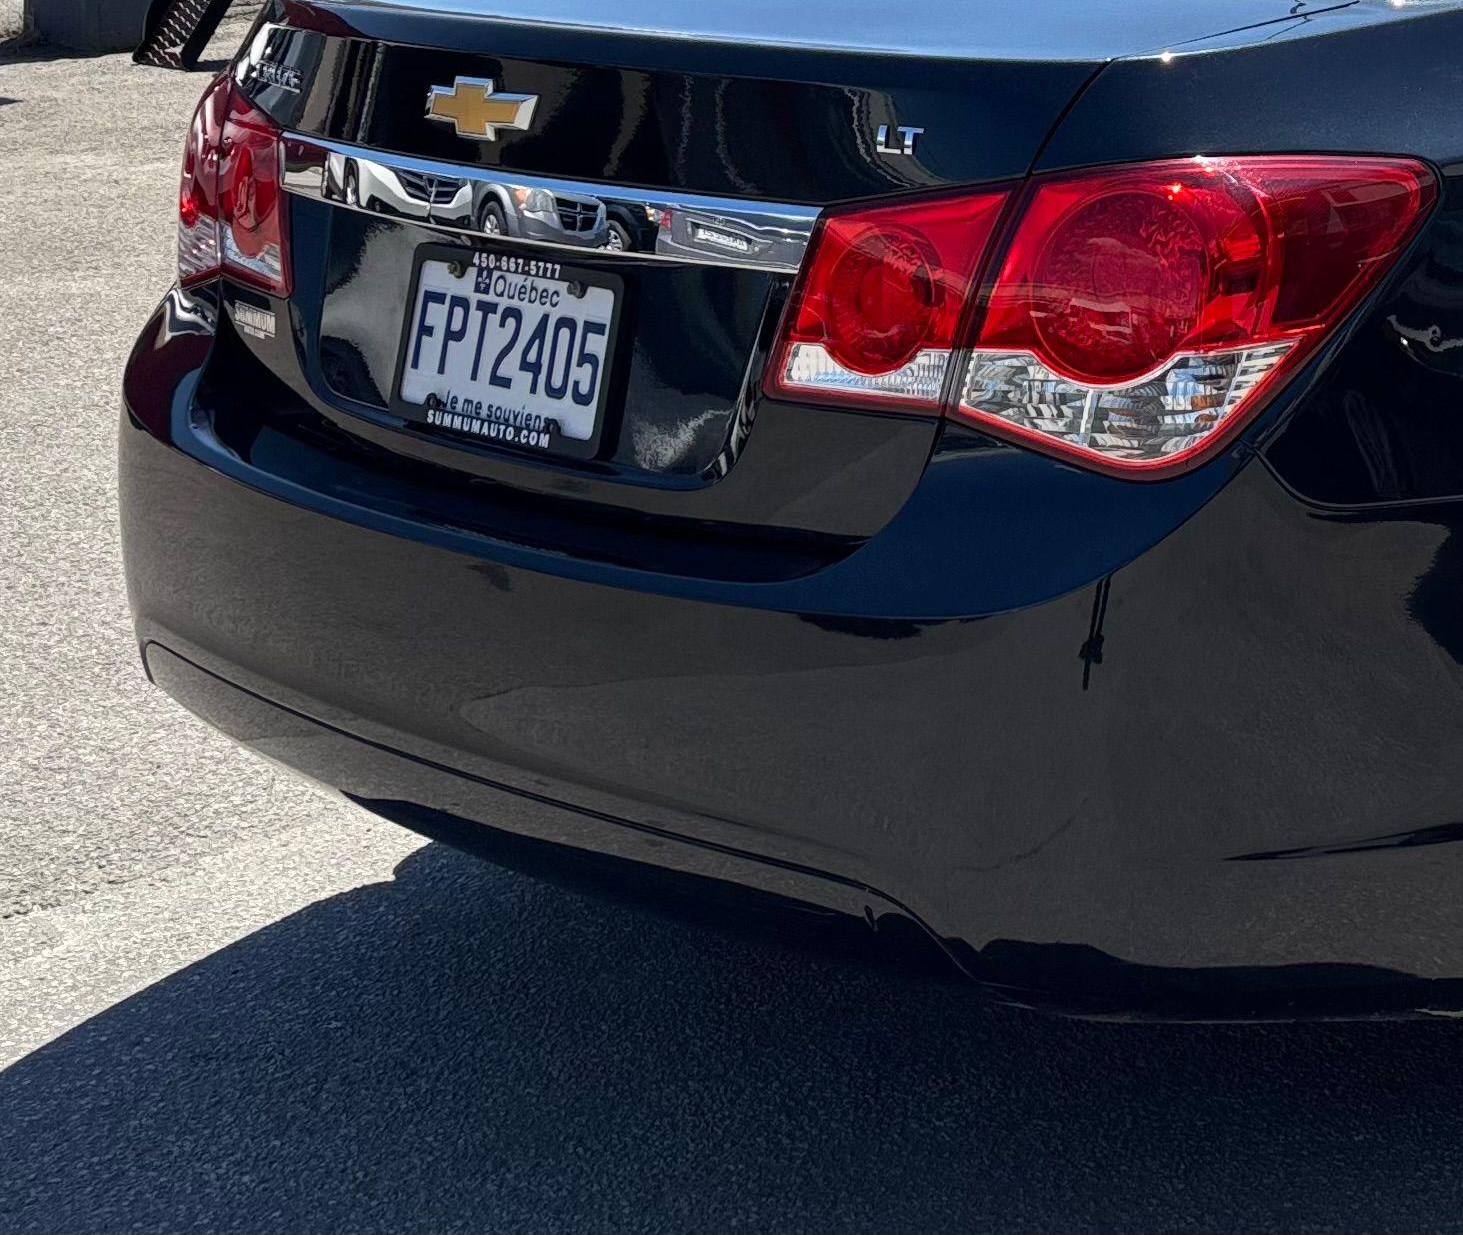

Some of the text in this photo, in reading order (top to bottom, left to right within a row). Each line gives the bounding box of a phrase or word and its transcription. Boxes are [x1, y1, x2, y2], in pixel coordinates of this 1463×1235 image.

[876, 125, 925, 155] LT
[494, 274, 560, 308] Québec
[410, 289, 607, 407] FPT2405
[426, 409, 550, 449] SUMMUMAUTO.COM
[462, 398, 482, 416] me
[486, 404, 547, 430] souvien
